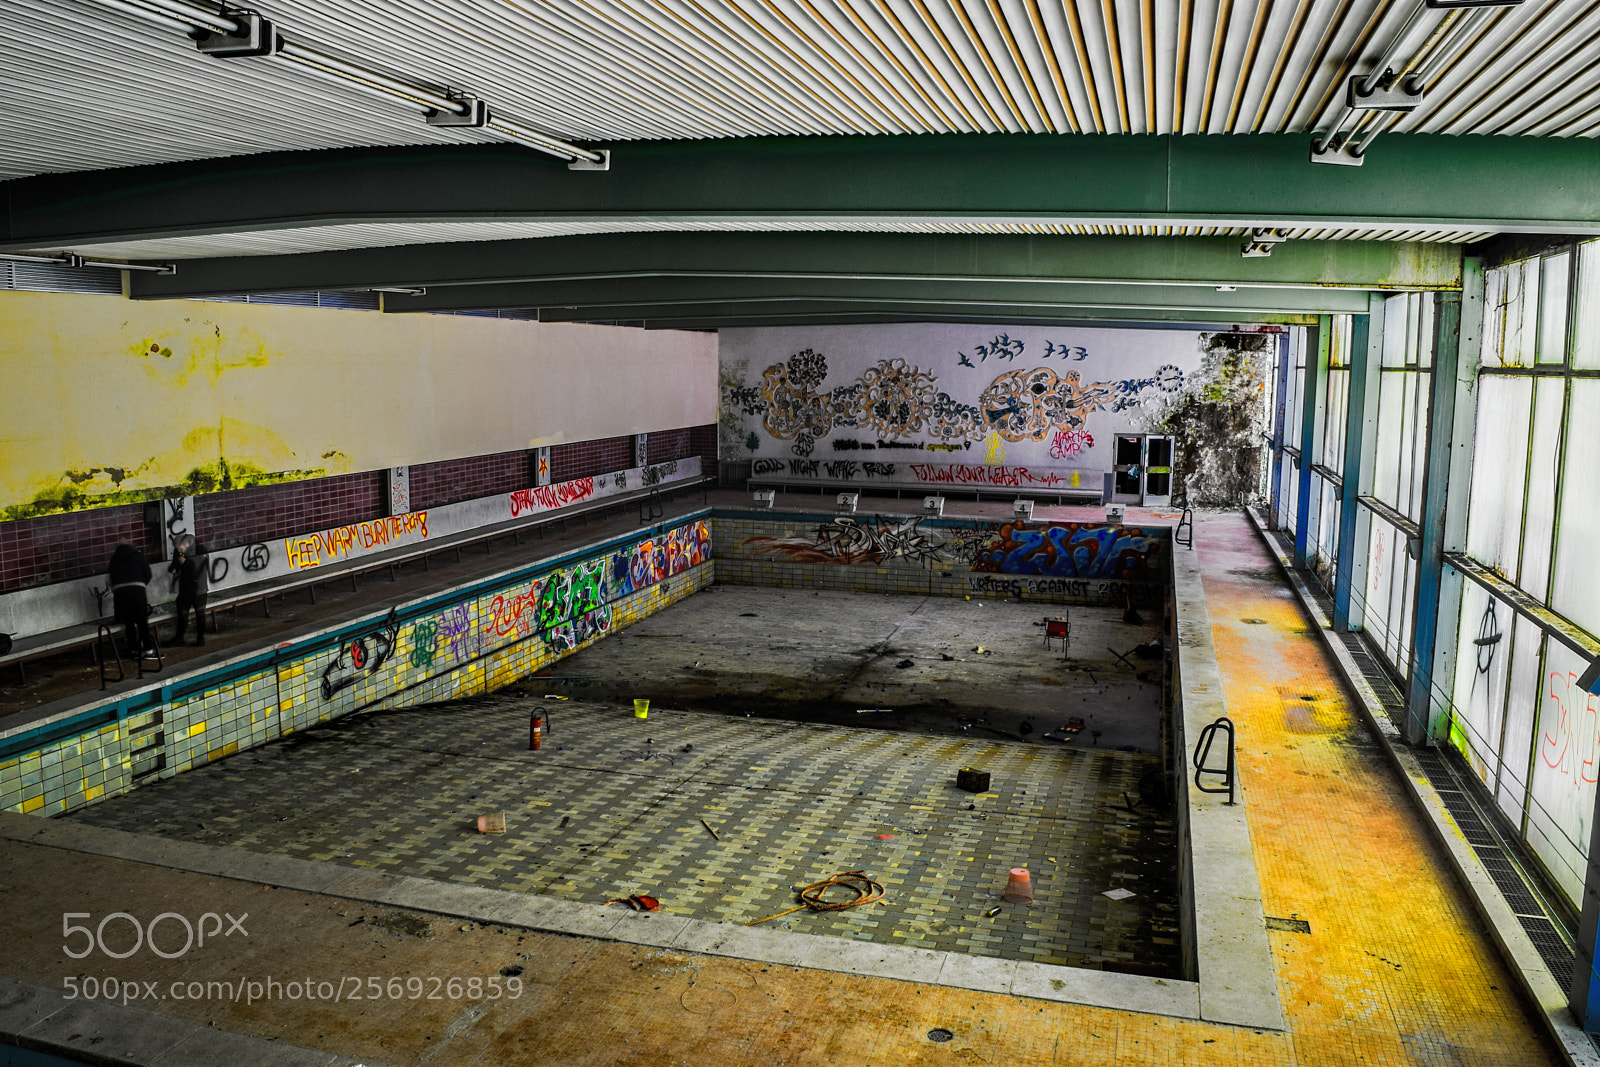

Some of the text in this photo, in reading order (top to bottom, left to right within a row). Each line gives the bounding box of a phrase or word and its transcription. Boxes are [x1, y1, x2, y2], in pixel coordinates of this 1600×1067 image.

[754, 459, 785, 475] GOOD
[788, 459, 820, 478] NIGHT
[909, 464, 954, 483] FOLLOW
[842, 496, 848, 504] 2
[929, 500, 935, 508] 3
[1019, 503, 1025, 511] 4
[1112, 507, 1118, 516] 5
[284, 533, 322, 570] KEEP
[318, 524, 363, 559] WARM
[361, 518, 390, 550] BURN
[387, 515, 404, 541] THE
[967, 575, 1022, 597] WRITERS
[1026, 577, 1091, 598] AGAINST
